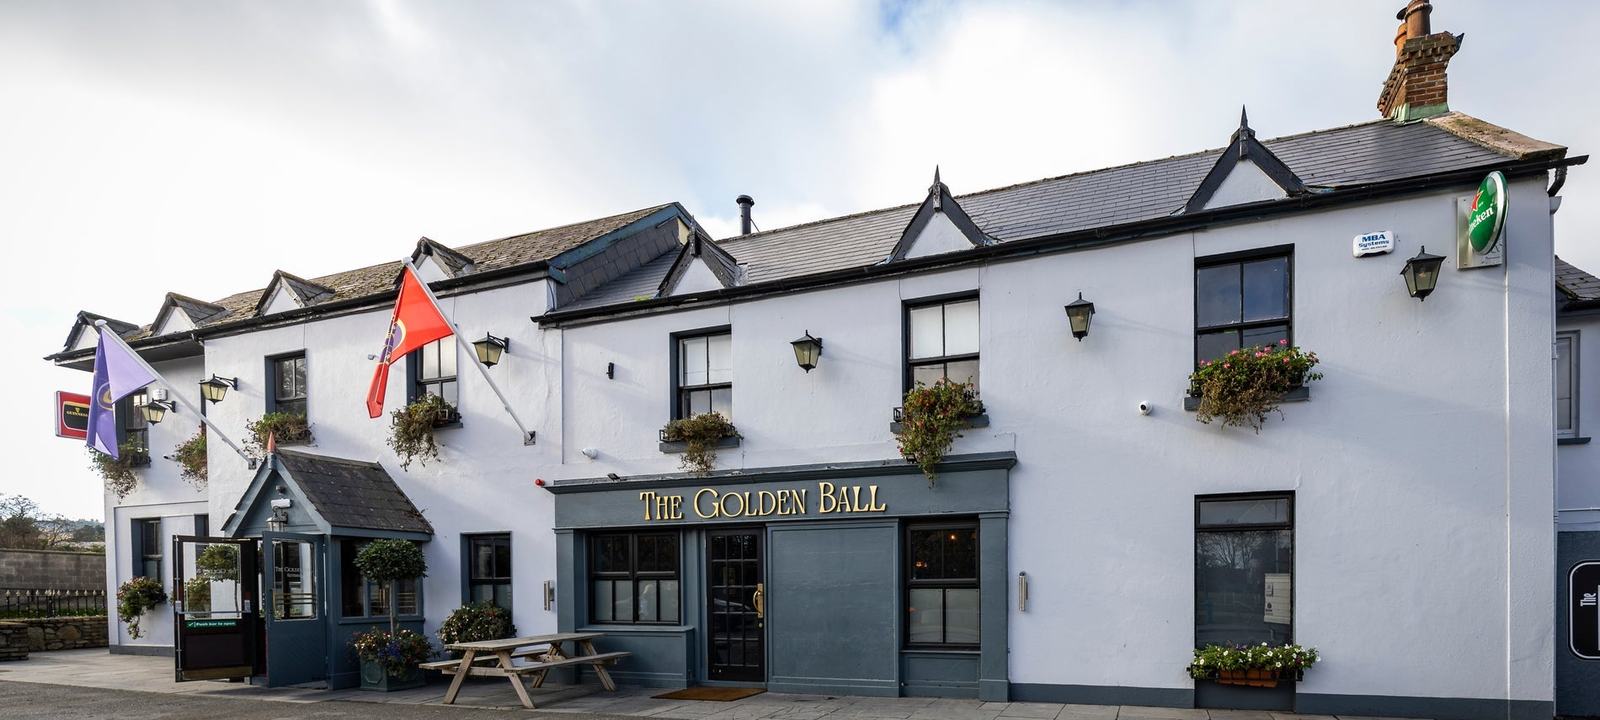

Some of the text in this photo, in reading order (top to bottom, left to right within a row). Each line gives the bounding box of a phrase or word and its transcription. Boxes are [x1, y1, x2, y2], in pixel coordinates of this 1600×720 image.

[1361, 234, 1386, 242] MBA
[1358, 240, 1389, 248] Systems
[639, 482, 887, 521] THE GOLDEN BALL
[1580, 592, 1597, 607] The
